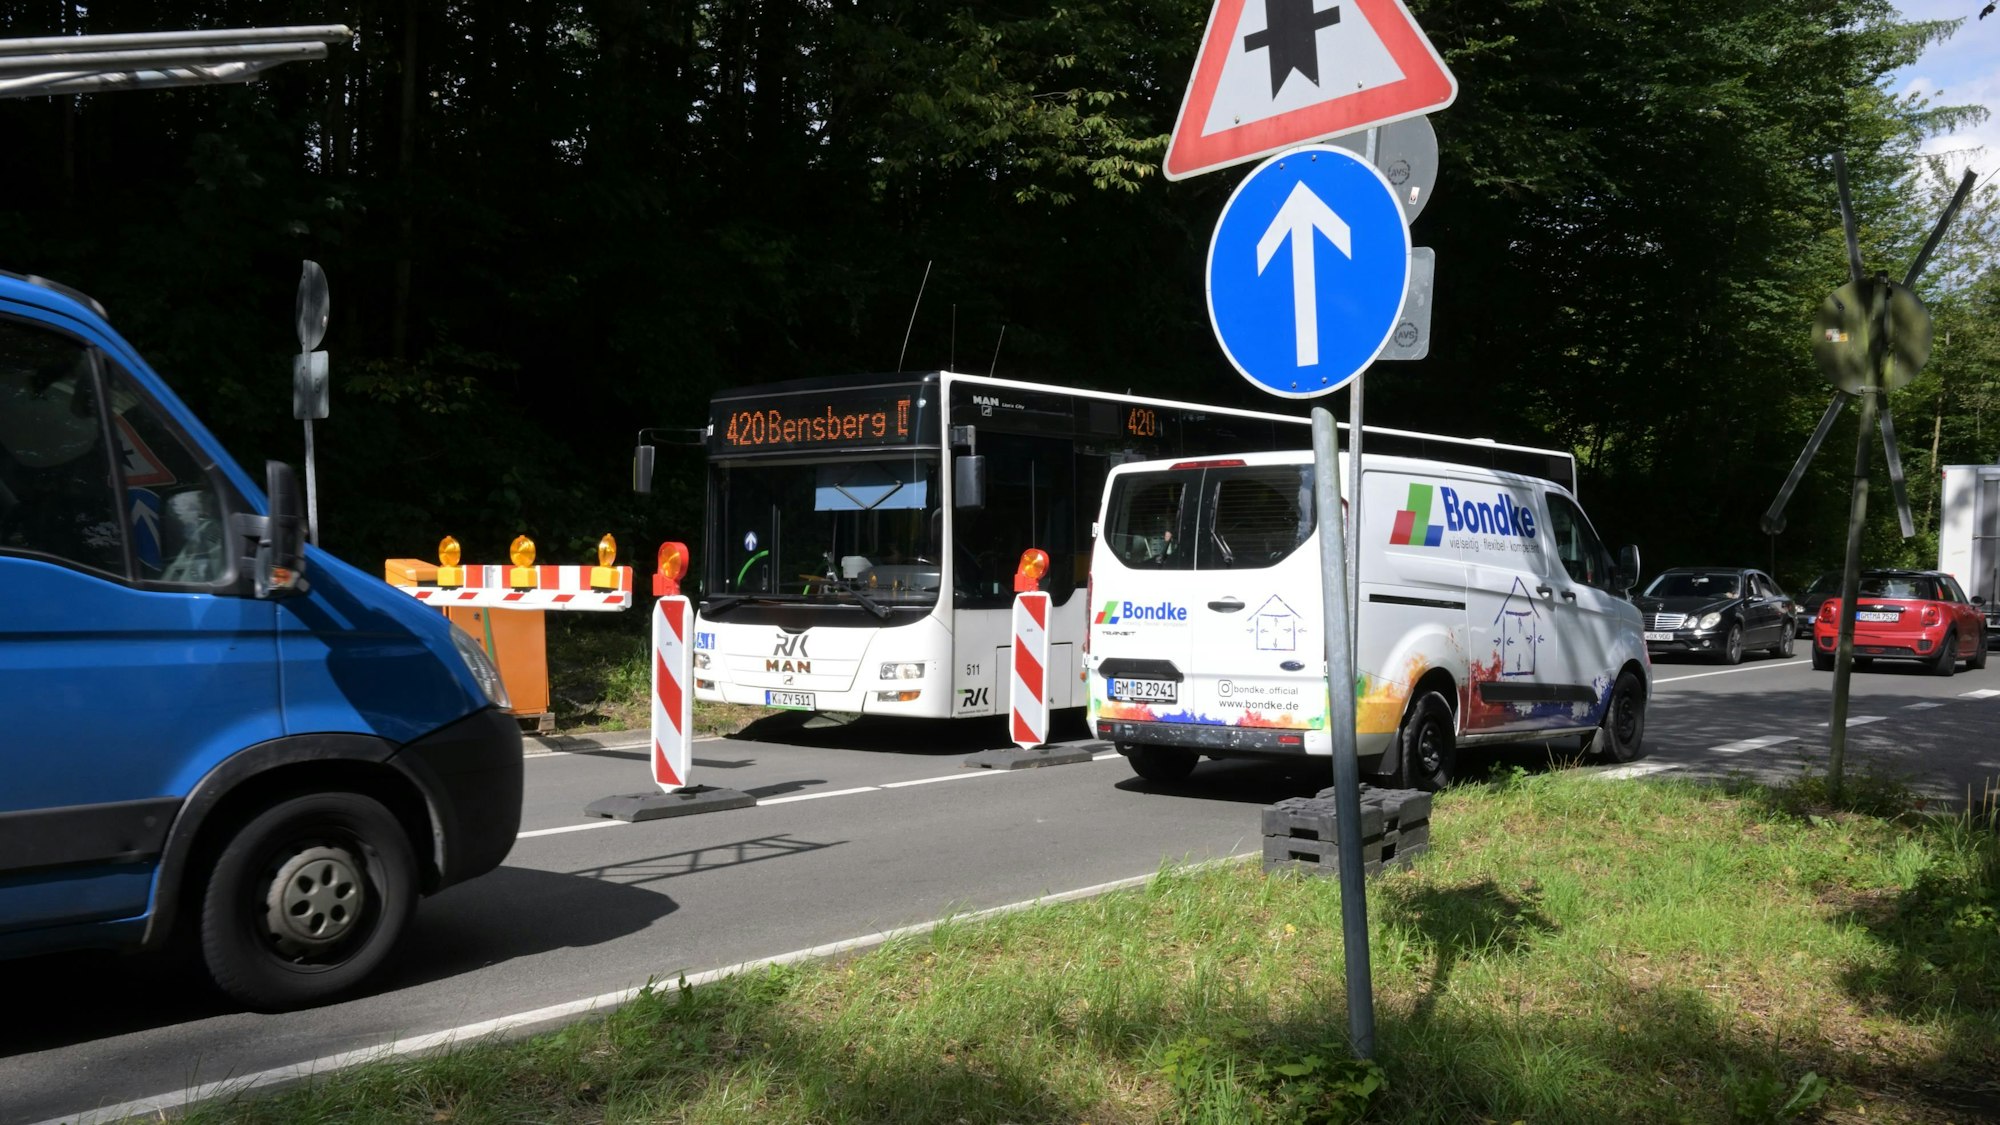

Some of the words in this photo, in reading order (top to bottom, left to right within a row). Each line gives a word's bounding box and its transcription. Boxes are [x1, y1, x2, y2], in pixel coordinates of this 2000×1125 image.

[1397, 330, 1415, 340] AVS
[972, 395, 999, 407] MAN
[727, 411, 765, 445] 420
[768, 405, 886, 443] Bensberg
[1128, 408, 1156, 436] 420
[1440, 486, 1536, 539] Bondke
[1449, 537, 1479, 552] vielseitig
[1483, 538, 1506, 551] flexibel
[1510, 541, 1540, 554] kompetent
[1123, 601, 1187, 620] Bondke
[766, 659, 811, 673] MAN
[966, 664, 980, 676] 511
[1114, 681, 1129, 695] GM
[1136, 682, 1143, 695] B
[1145, 682, 1175, 697] 2941
[1234, 686, 1298, 695] bondke_official
[772, 694, 778, 703] K
[782, 694, 794, 705] ZY
[795, 694, 811, 706] 511
[1219, 700, 1299, 710] www.bondke.de
